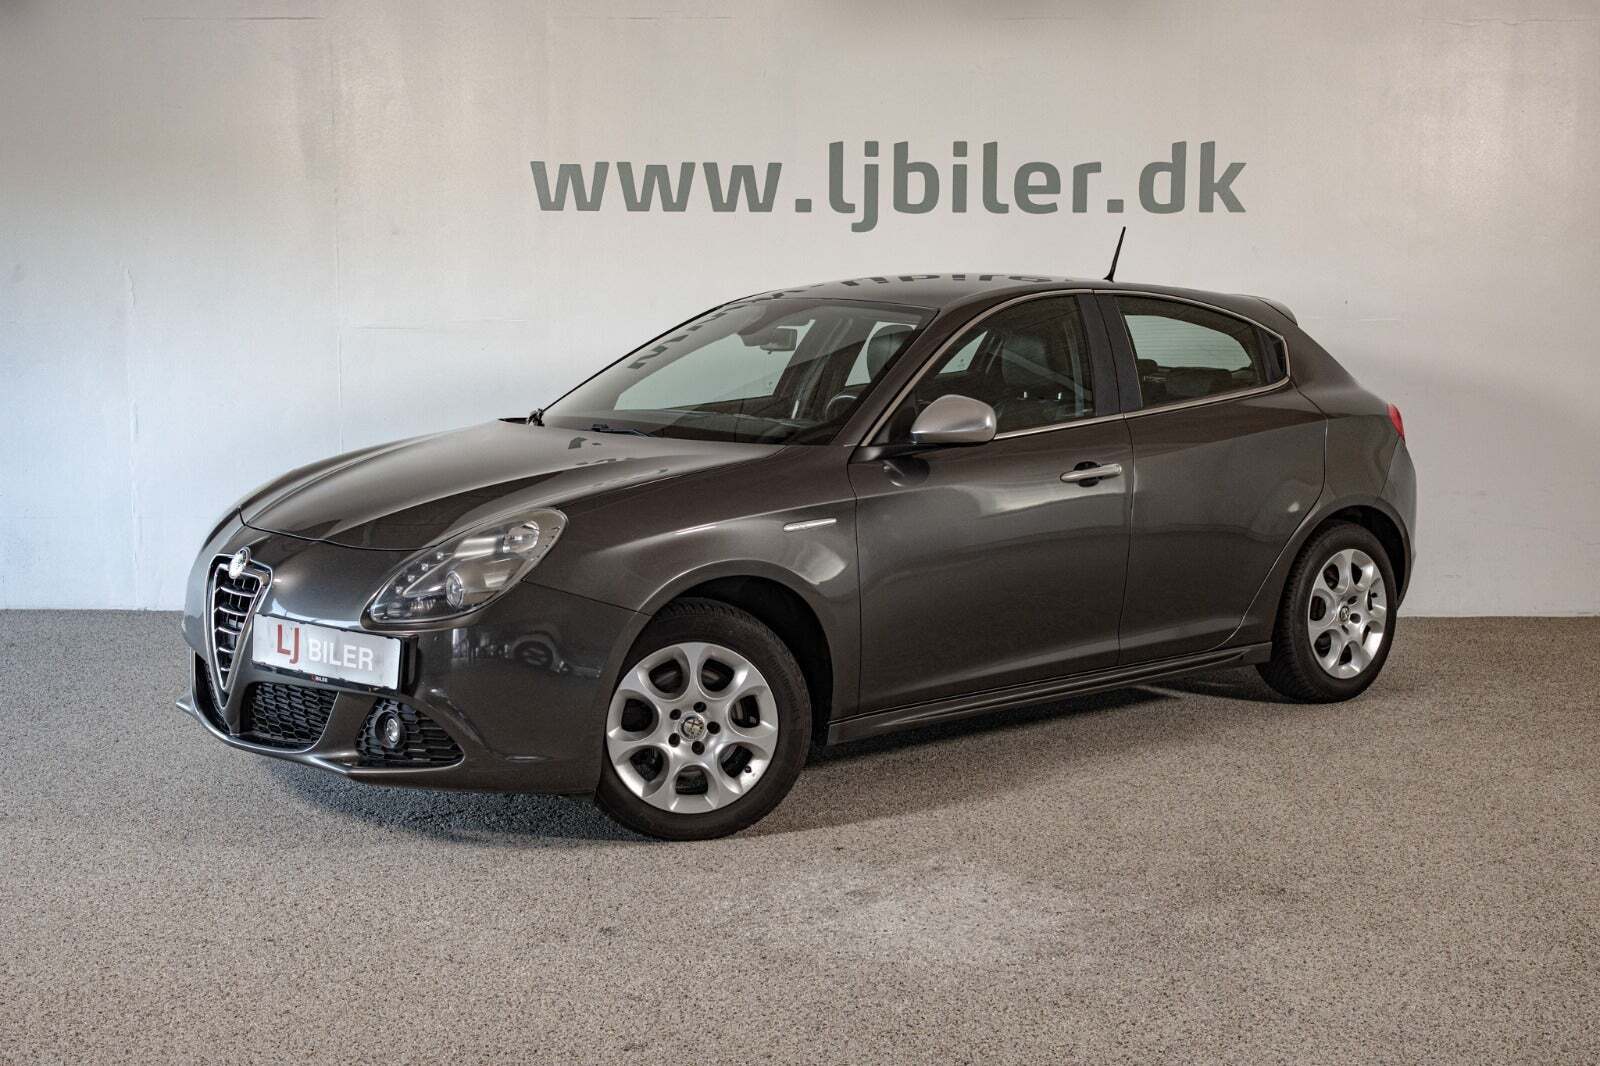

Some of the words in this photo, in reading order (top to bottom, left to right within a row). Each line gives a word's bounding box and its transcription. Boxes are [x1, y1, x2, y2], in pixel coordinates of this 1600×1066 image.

[530, 141, 1246, 233] www.ljbiler.dk
[277, 624, 300, 664] LJ
[308, 639, 374, 671] BILER
